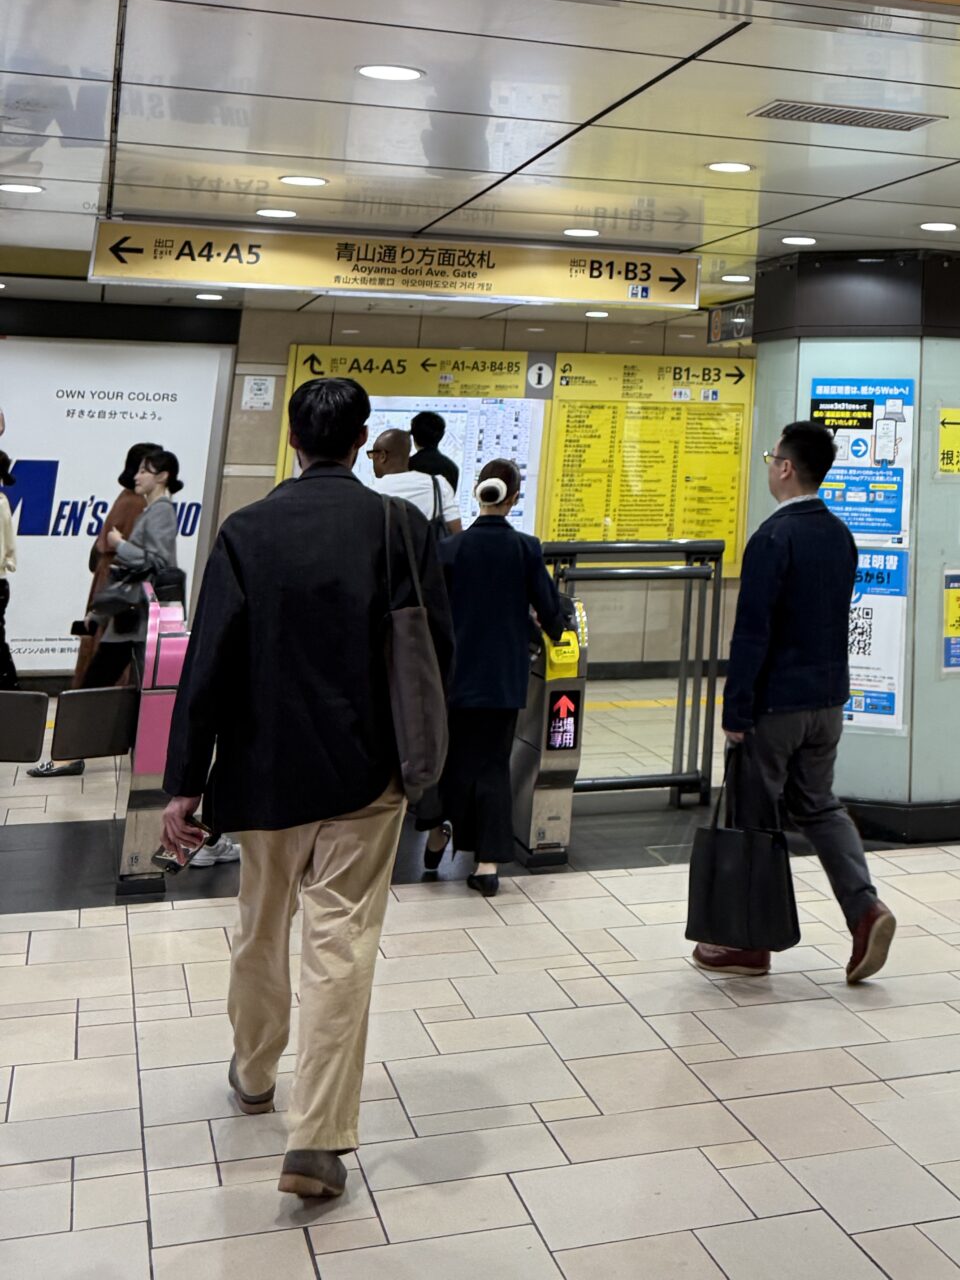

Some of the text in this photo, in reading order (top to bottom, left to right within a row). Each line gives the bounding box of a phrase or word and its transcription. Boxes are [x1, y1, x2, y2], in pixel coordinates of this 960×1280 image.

[155, 239, 174, 248] 出口
[336, 242, 496, 269] 青山通り方面改札
[570, 258, 586, 267] 出口
[352, 263, 478, 279] Aoyama-dori Ave. Gate
[56, 389, 178, 402] OWN YOUR COLORS
[66, 409, 162, 421] 好きな自分でいよう。
[550, 717, 575, 732] 出場
